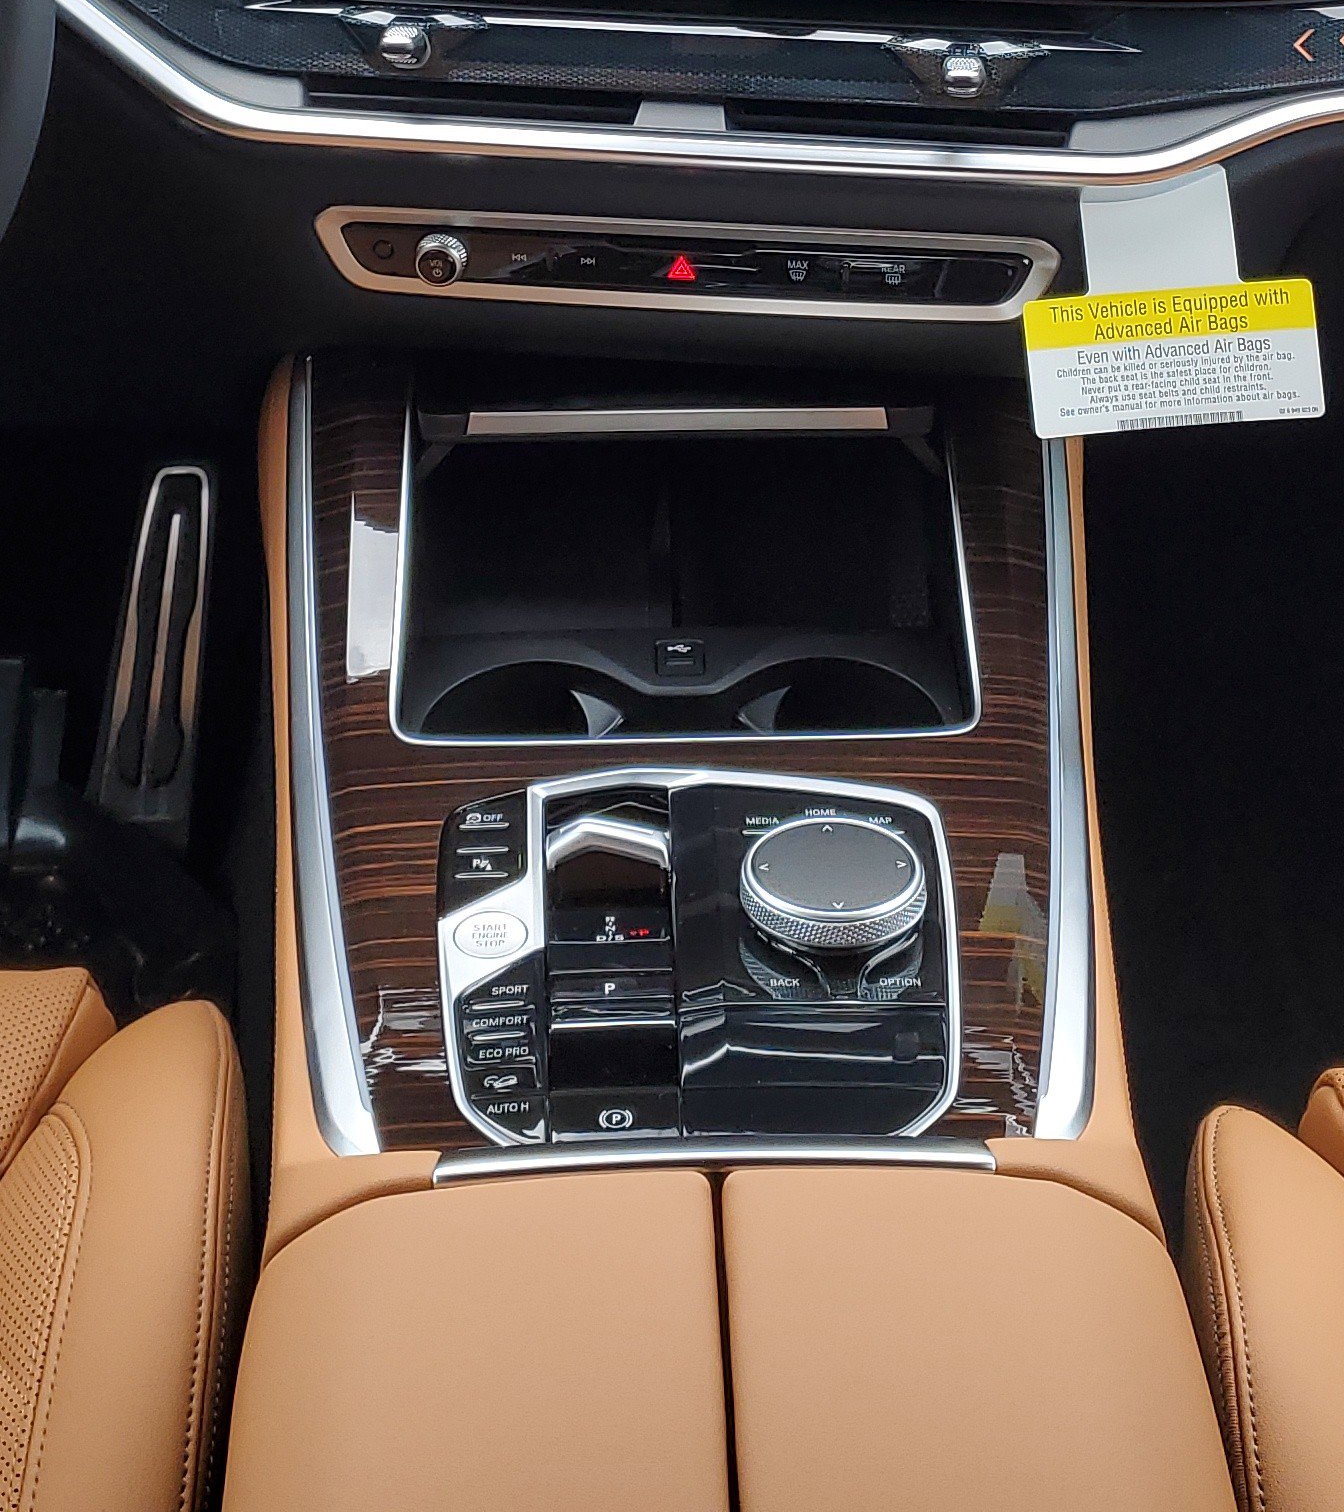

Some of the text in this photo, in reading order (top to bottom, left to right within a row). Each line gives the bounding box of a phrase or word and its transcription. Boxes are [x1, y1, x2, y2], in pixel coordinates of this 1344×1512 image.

[787, 259, 809, 270] MAX
[1049, 288, 1290, 323] This Vehicle is Equipped with
[1094, 314, 1248, 341] Advanced Air Bags
[1077, 337, 1271, 365] Even with Advanced Air Bags
[1056, 351, 1295, 378] Children can be killed or seriously injured by the air bag.
[1081, 363, 1272, 385] The back seat is the safest place for children.
[1081, 386, 1105, 395] Never
[1108, 384, 1122, 395] put
[1132, 378, 1177, 391] rear-facing
[1179, 377, 1200, 387] child
[1203, 375, 1221, 385] seat
[1223, 374, 1231, 383] in
[1233, 373, 1247, 383] the
[1250, 371, 1274, 382] front.
[1089, 382, 1268, 405] Always use seat belts and child restraints.
[1060, 389, 1301, 417] See owner's manual for more information about air bags.
[483, 813, 504, 822] OFF
[805, 808, 836, 817] HOME
[745, 816, 780, 826] MEDIA
[868, 816, 892, 825] MAP
[473, 923, 507, 932] START
[475, 940, 506, 948] STOP
[605, 982, 616, 995] P
[770, 978, 800, 987] BACK
[879, 977, 922, 987] OPTION
[491, 984, 529, 996] SPORT
[472, 1015, 528, 1028] COMFORT
[479, 1046, 529, 1059] ECO PRO
[486, 1101, 529, 1115] AUTO H
